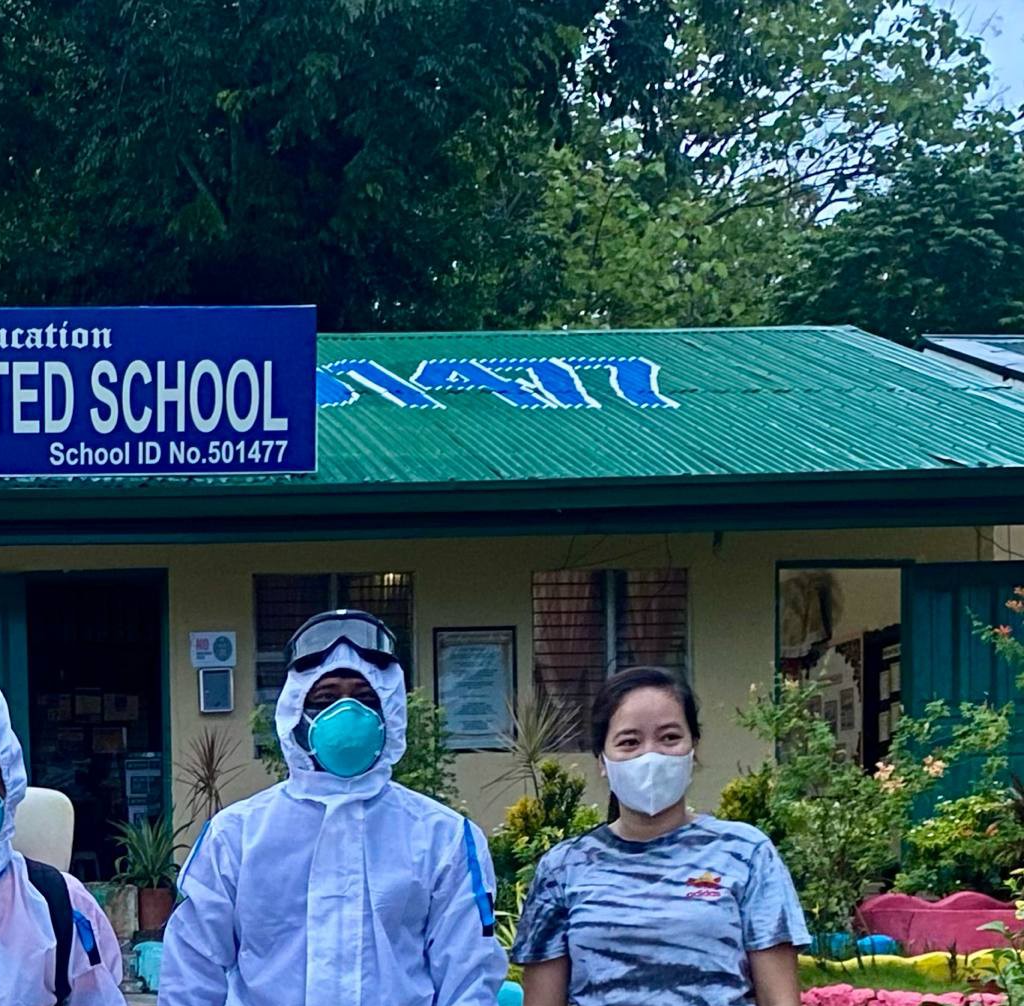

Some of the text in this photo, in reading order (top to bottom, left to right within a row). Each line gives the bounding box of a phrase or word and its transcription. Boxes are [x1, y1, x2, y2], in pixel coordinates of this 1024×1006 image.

[90, 359, 288, 434] SCHOOL
[49, 441, 130, 466] School
[138, 441, 161, 465] ID
